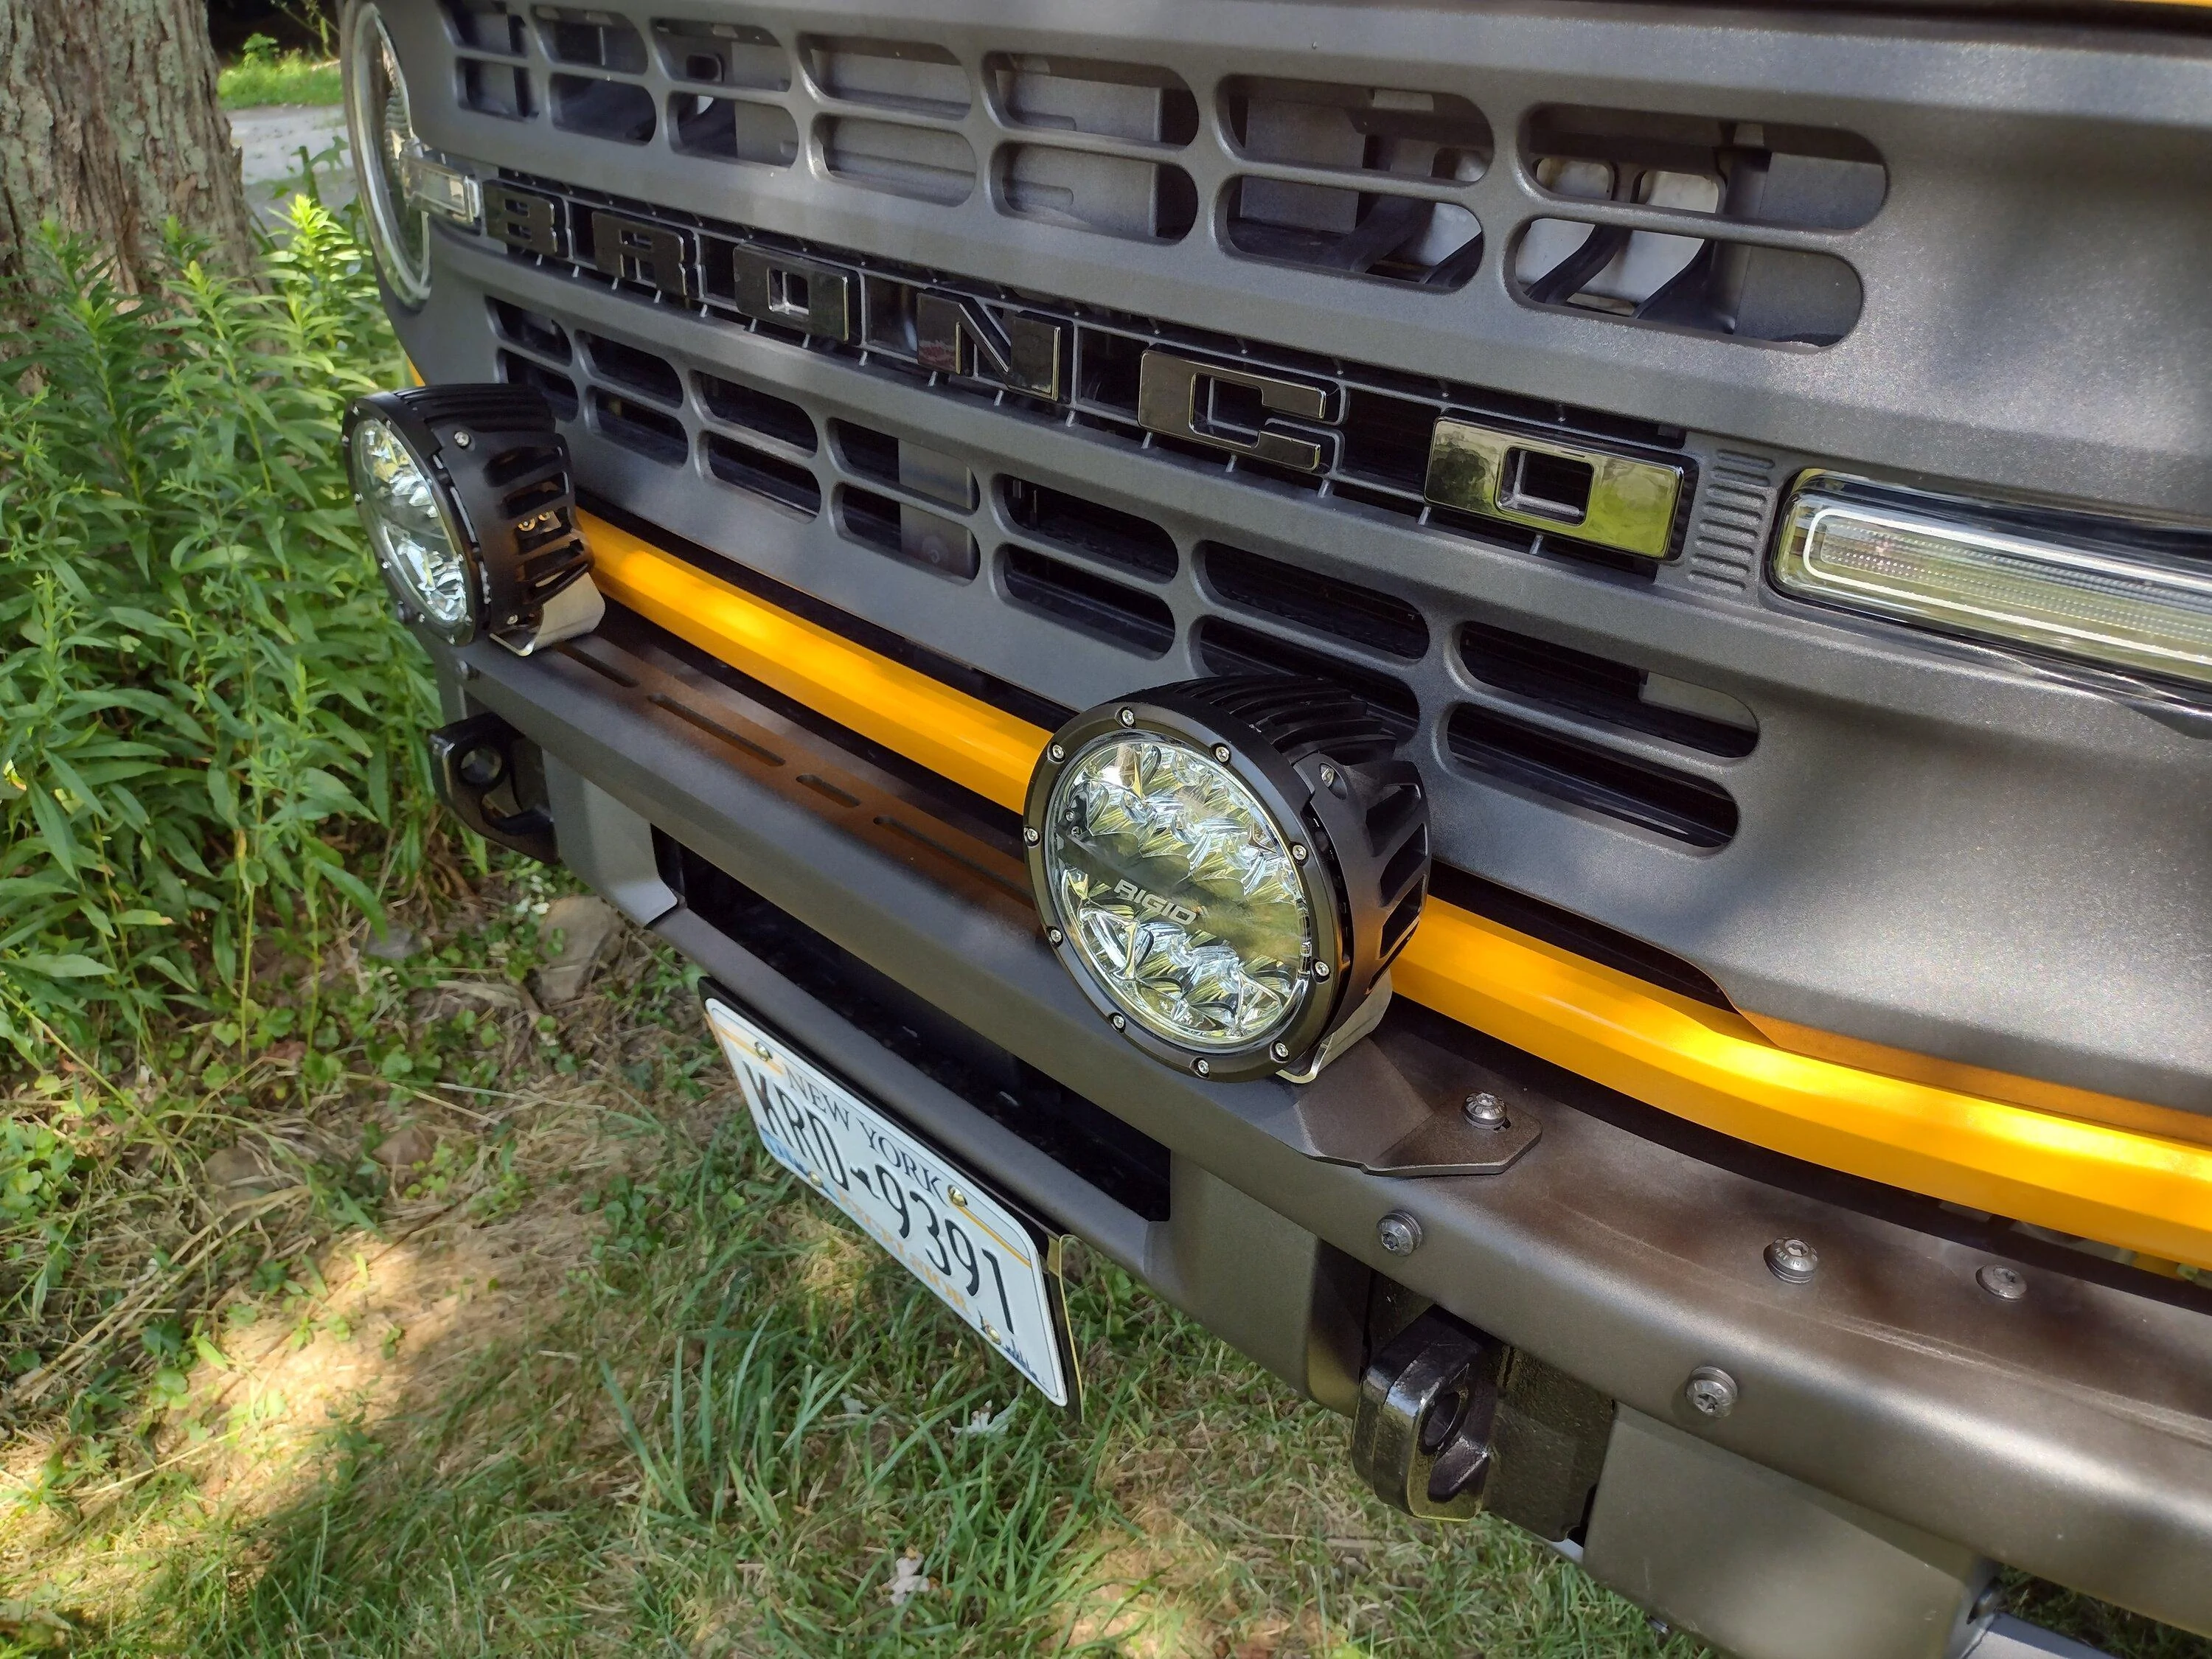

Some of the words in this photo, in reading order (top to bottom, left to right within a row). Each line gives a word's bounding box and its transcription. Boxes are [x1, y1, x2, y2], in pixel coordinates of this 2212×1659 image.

[482, 179, 1684, 560] BRONCO
[1113, 879, 1196, 925] RIGID
[783, 1062, 849, 1131] NEW
[855, 1116, 950, 1208] YORK
